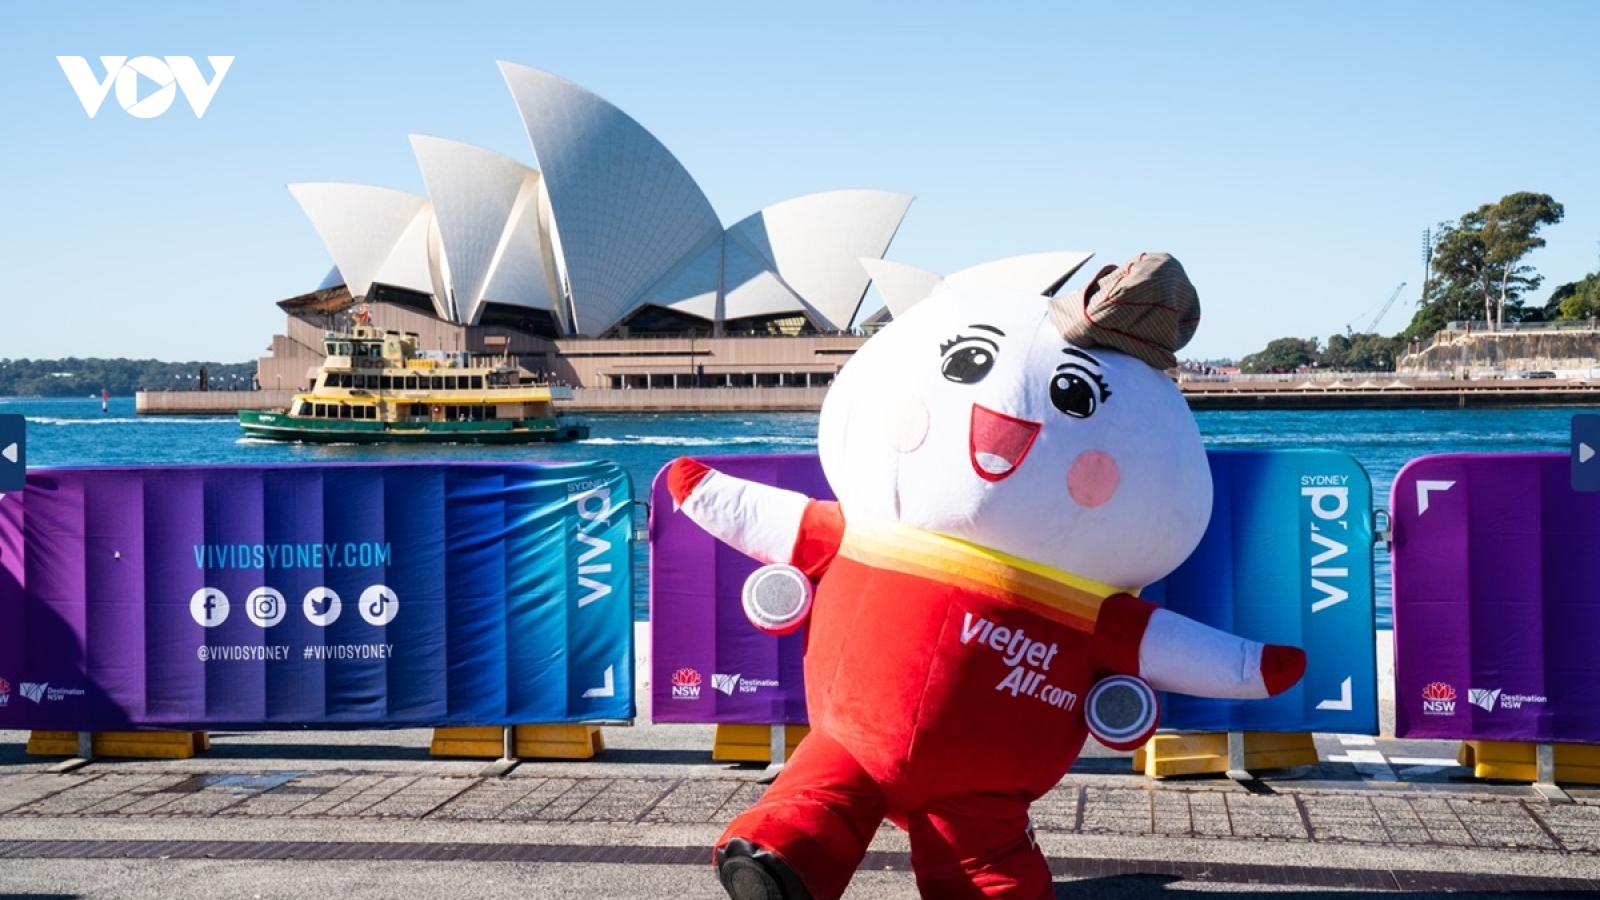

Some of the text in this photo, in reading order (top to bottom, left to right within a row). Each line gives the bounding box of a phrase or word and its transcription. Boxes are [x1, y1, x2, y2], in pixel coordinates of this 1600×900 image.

[1301, 475, 1349, 485] SYDNEY
[567, 479, 610, 492] SYDNEY
[194, 542, 392, 569] VIVIDSYDNEY.COM
[197, 644, 394, 661] @VIVIDSYDNEY #VIVIDSYDNEY
[672, 686, 701, 696] NSW
[1501, 694, 1547, 702] Destination
[1423, 701, 1456, 711] NSW
[1501, 701, 1521, 709] NSW
